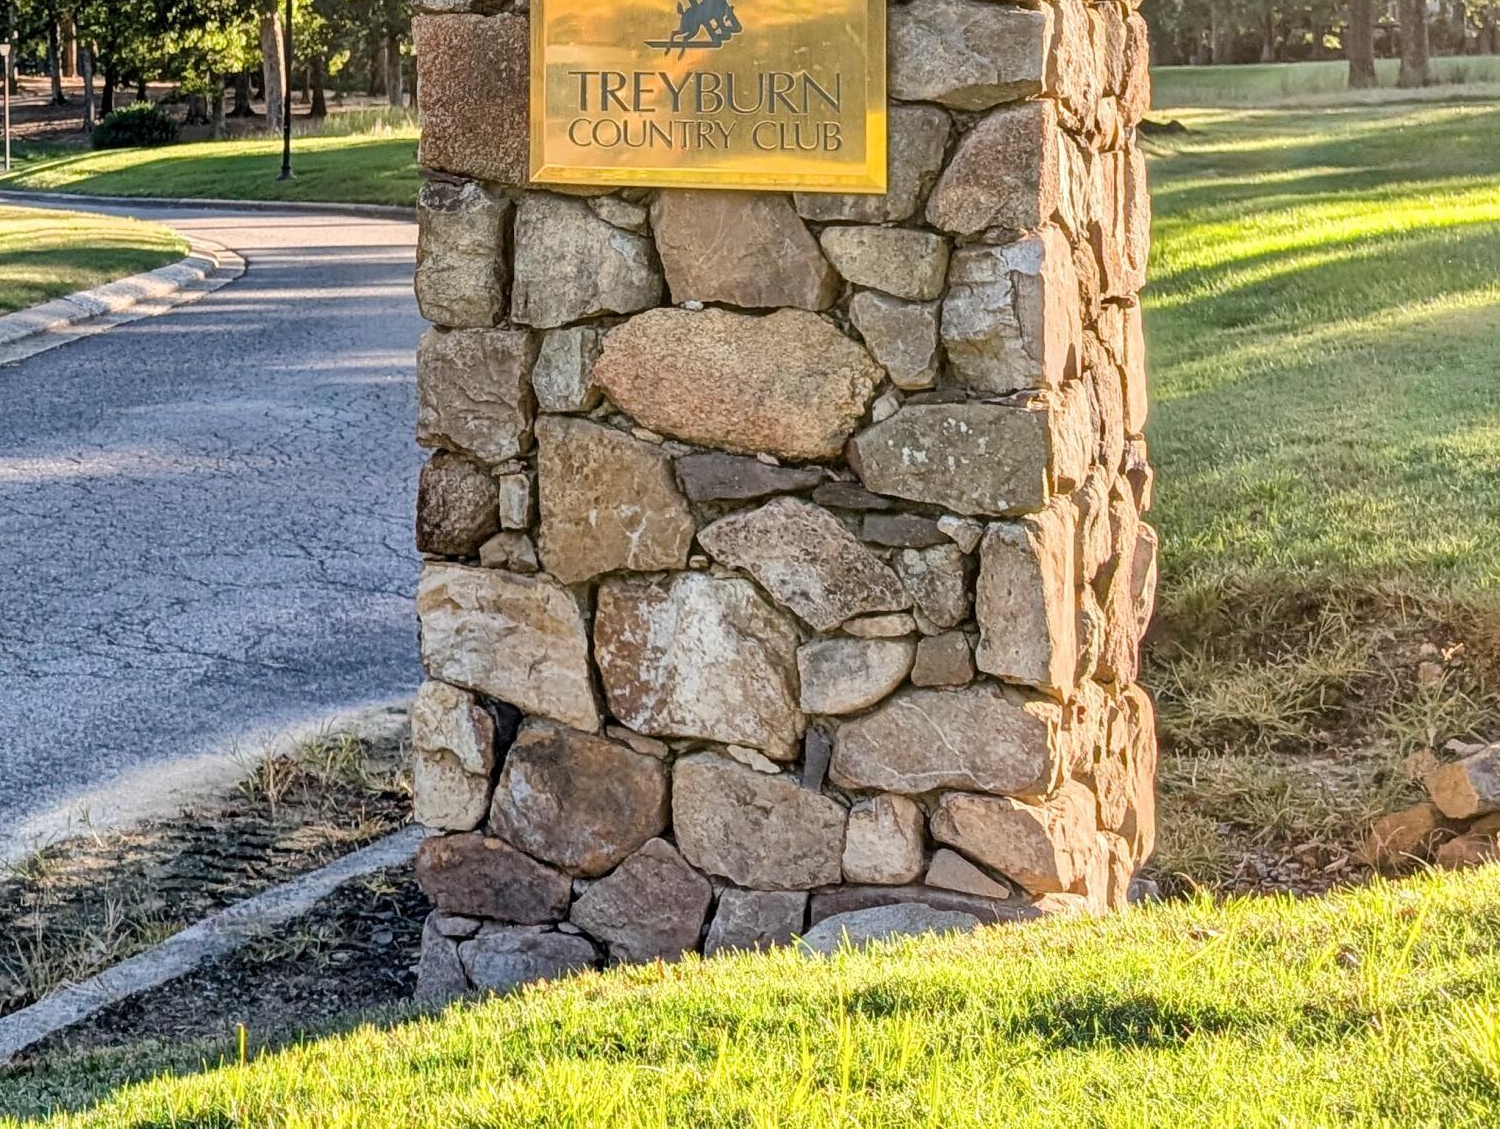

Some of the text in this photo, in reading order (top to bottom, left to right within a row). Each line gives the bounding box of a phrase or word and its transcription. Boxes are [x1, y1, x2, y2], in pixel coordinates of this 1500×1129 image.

[567, 71, 841, 115] TREYBURN
[567, 118, 843, 152] COUNTRY CLUB
